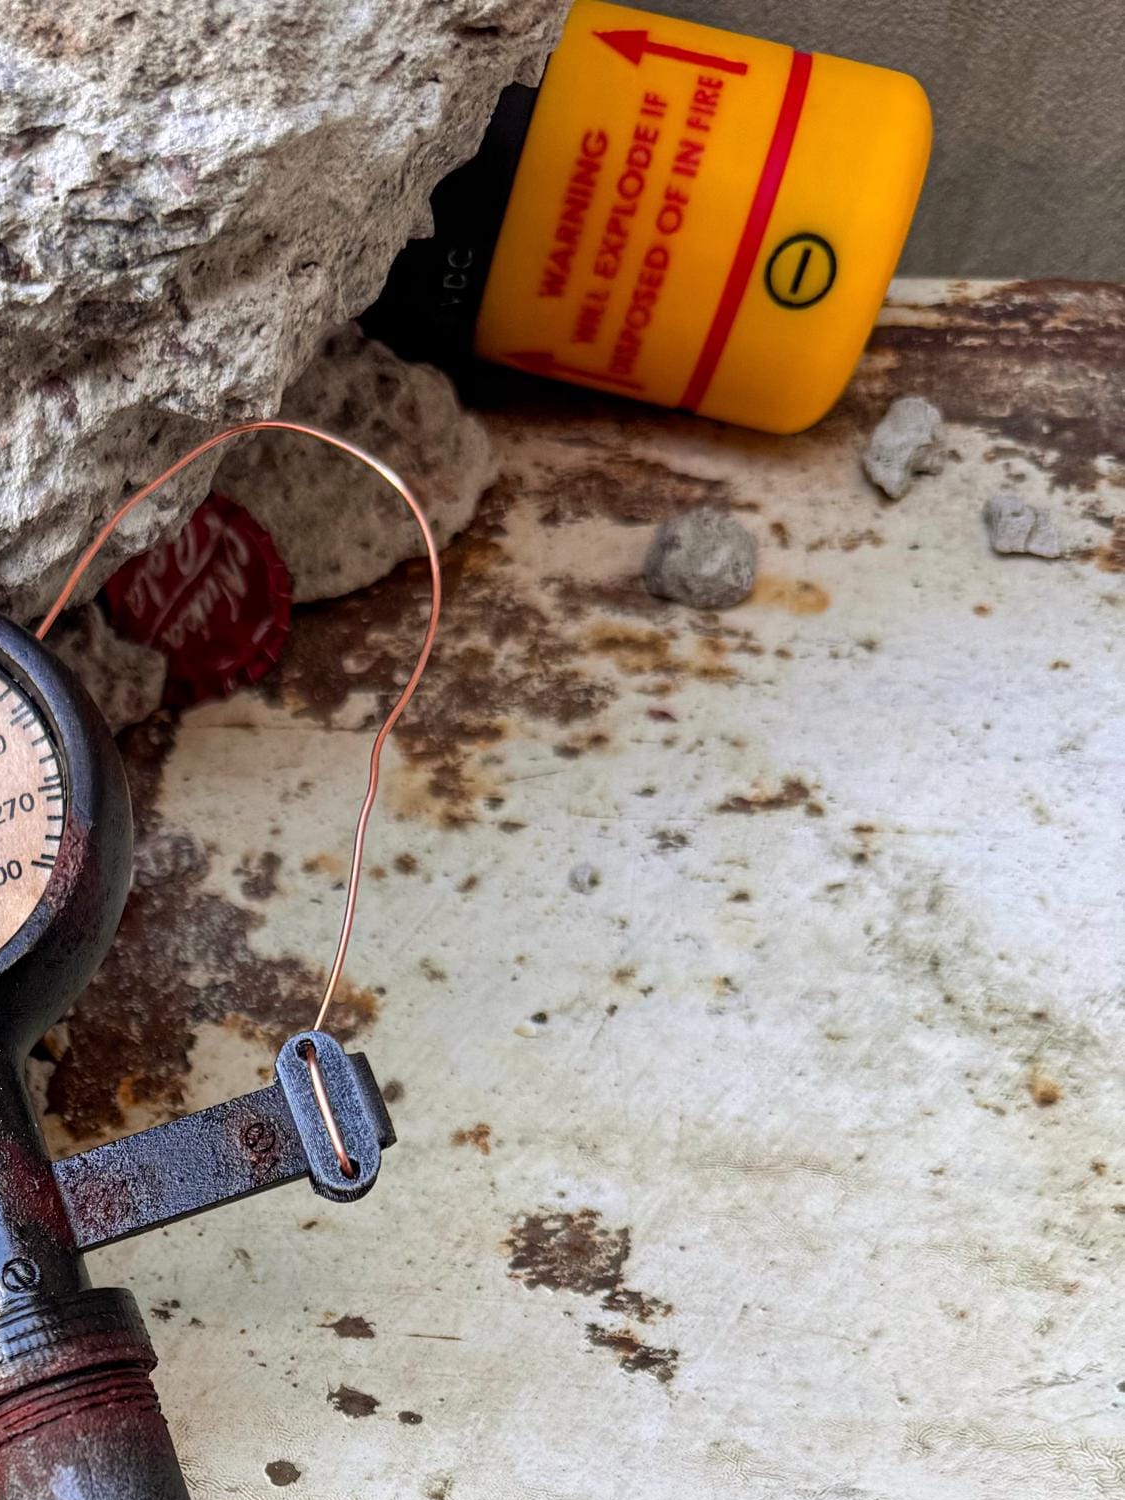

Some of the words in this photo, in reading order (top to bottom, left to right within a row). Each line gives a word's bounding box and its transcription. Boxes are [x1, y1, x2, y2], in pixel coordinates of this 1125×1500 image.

[685, 75, 724, 133] FIRE
[671, 138, 705, 179] IN
[538, 127, 609, 300] WARNING
[572, 281, 611, 345] WILL
[594, 127, 660, 281] EXPLODE
[640, 89, 668, 119] IF
[654, 187, 689, 237] OF
